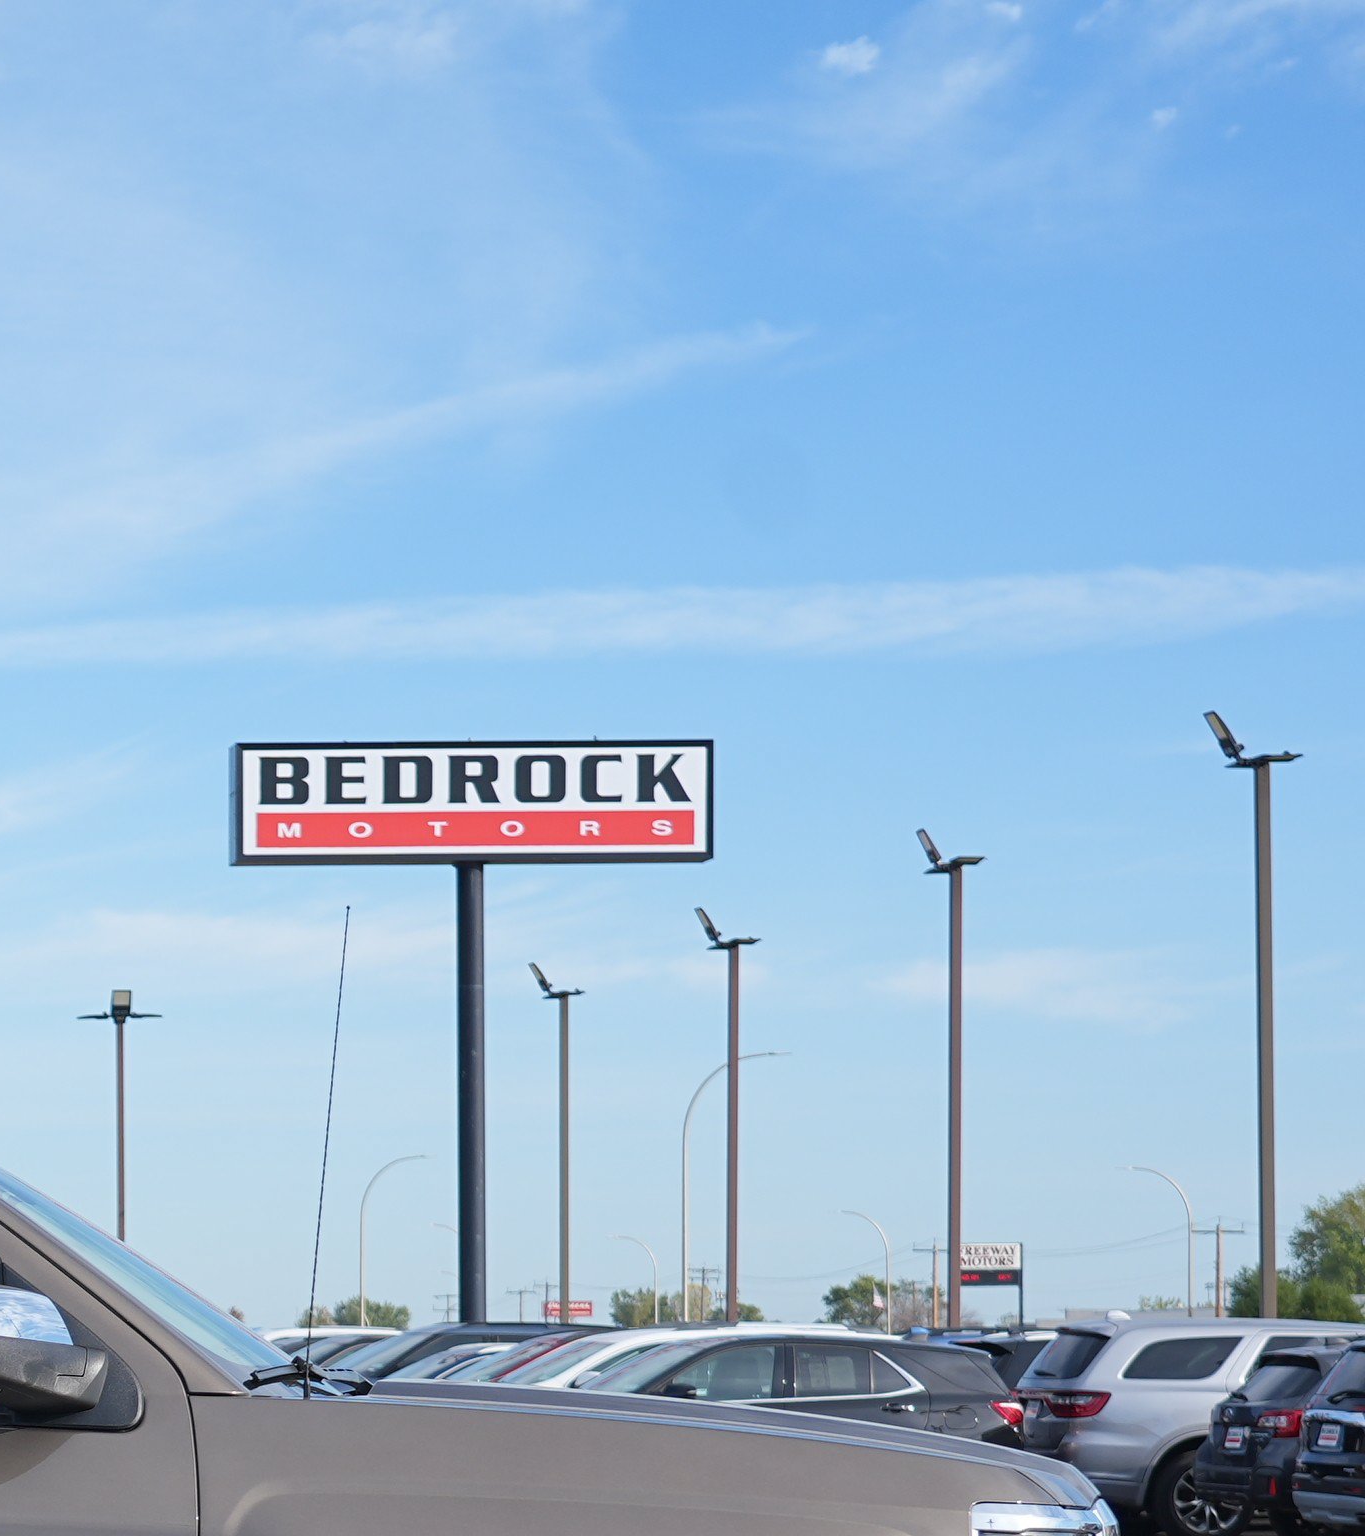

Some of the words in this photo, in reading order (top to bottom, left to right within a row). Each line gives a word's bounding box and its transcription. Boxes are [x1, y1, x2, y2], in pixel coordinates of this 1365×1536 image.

[258, 754, 691, 805] BEDROCK
[277, 819, 674, 838] MOTORS
[960, 1256, 1014, 1266] MOTORS
